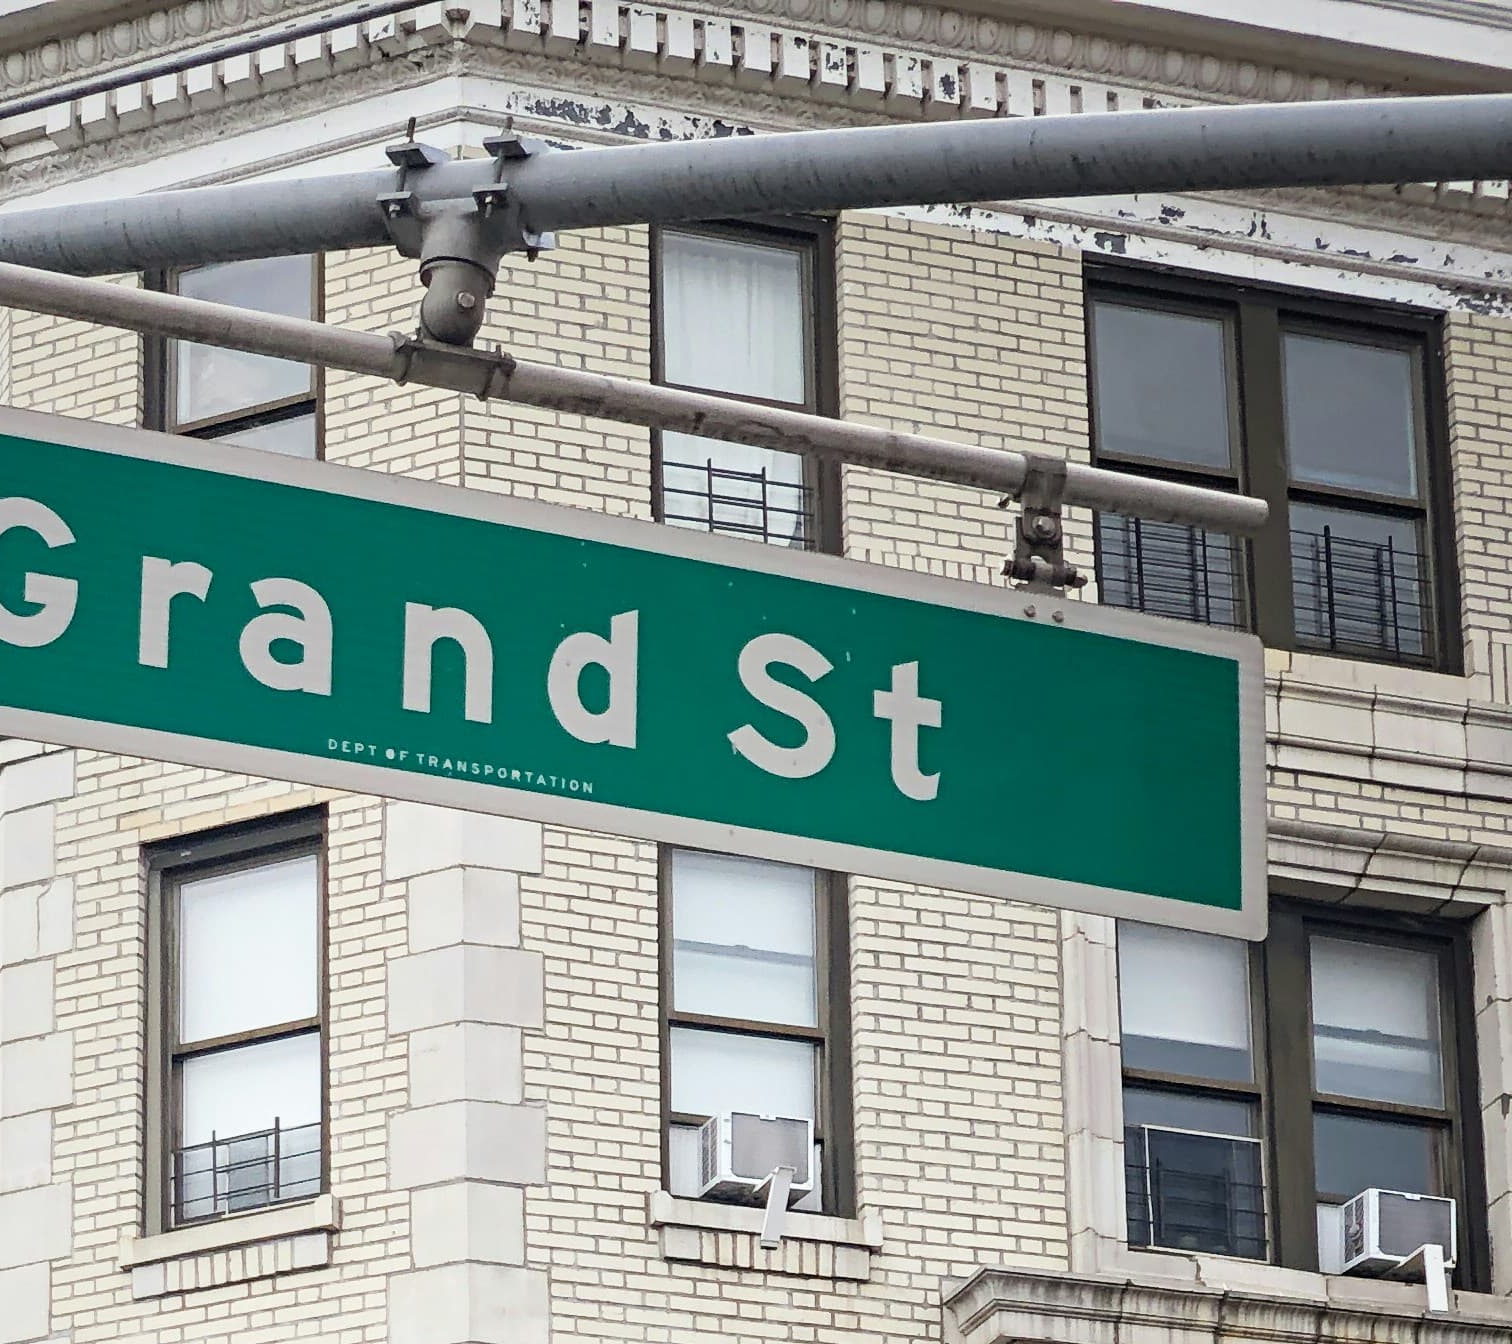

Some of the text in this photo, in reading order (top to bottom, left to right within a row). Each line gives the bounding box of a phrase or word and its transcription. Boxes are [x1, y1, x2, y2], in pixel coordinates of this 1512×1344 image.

[328, 738, 593, 794] DEPT OF TRANSPORTATION
[726, 631, 942, 801] St
